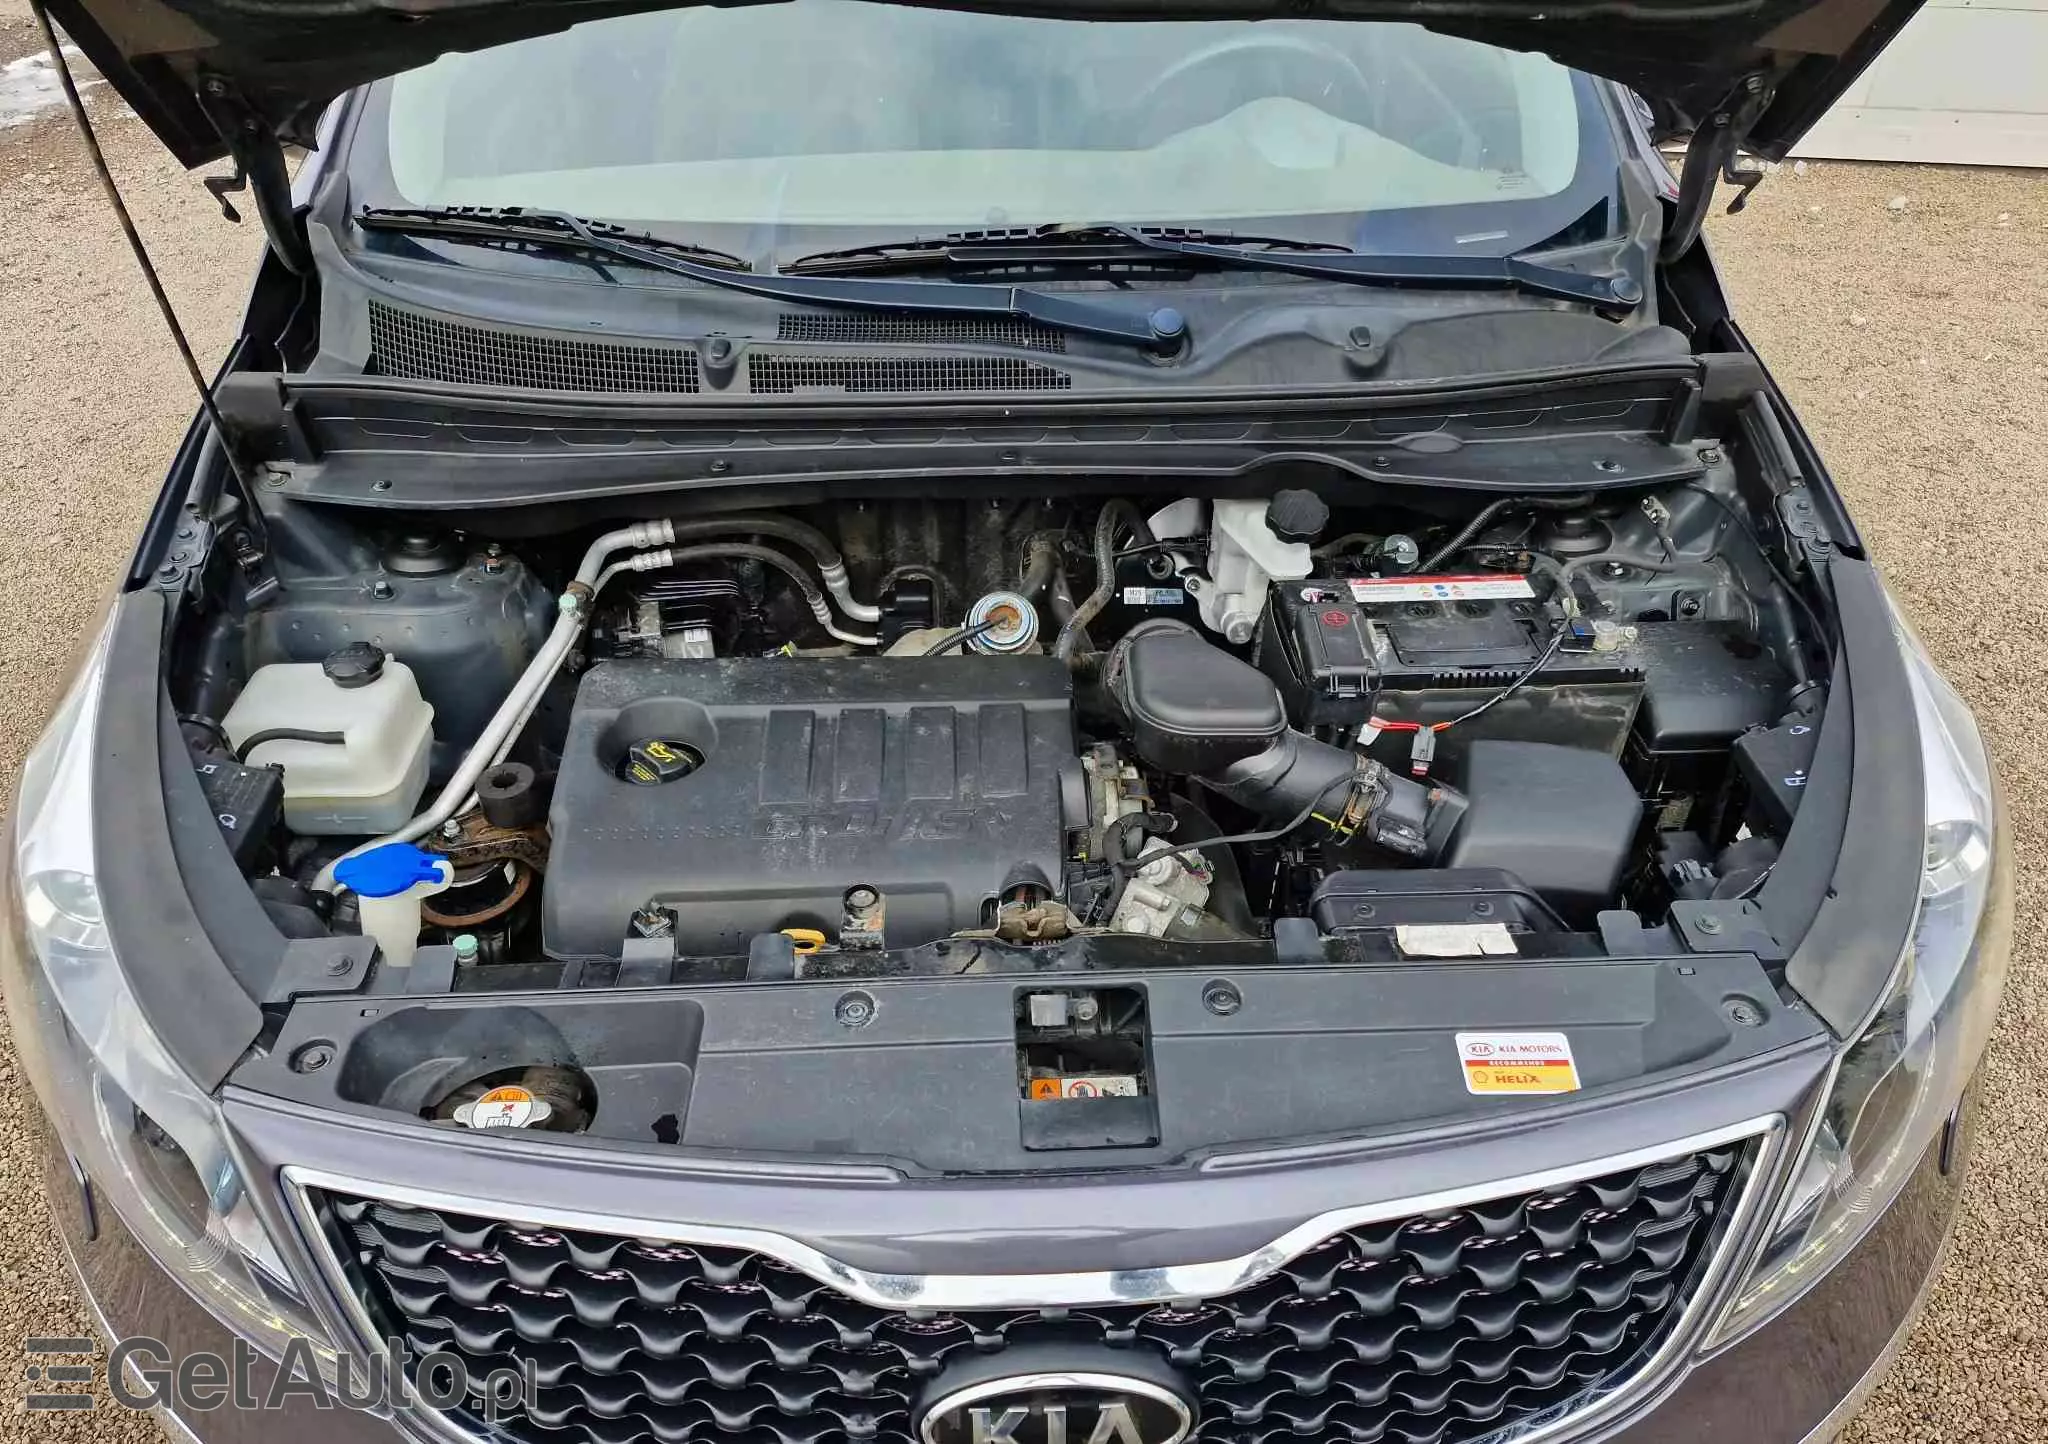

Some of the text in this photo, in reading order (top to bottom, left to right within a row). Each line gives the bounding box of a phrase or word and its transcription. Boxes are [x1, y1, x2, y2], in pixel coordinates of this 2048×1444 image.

[1471, 1045, 1491, 1053] KIA
[1499, 1044, 1562, 1053] KIA MOTORS
[1495, 1075, 1541, 1084] HELIX
